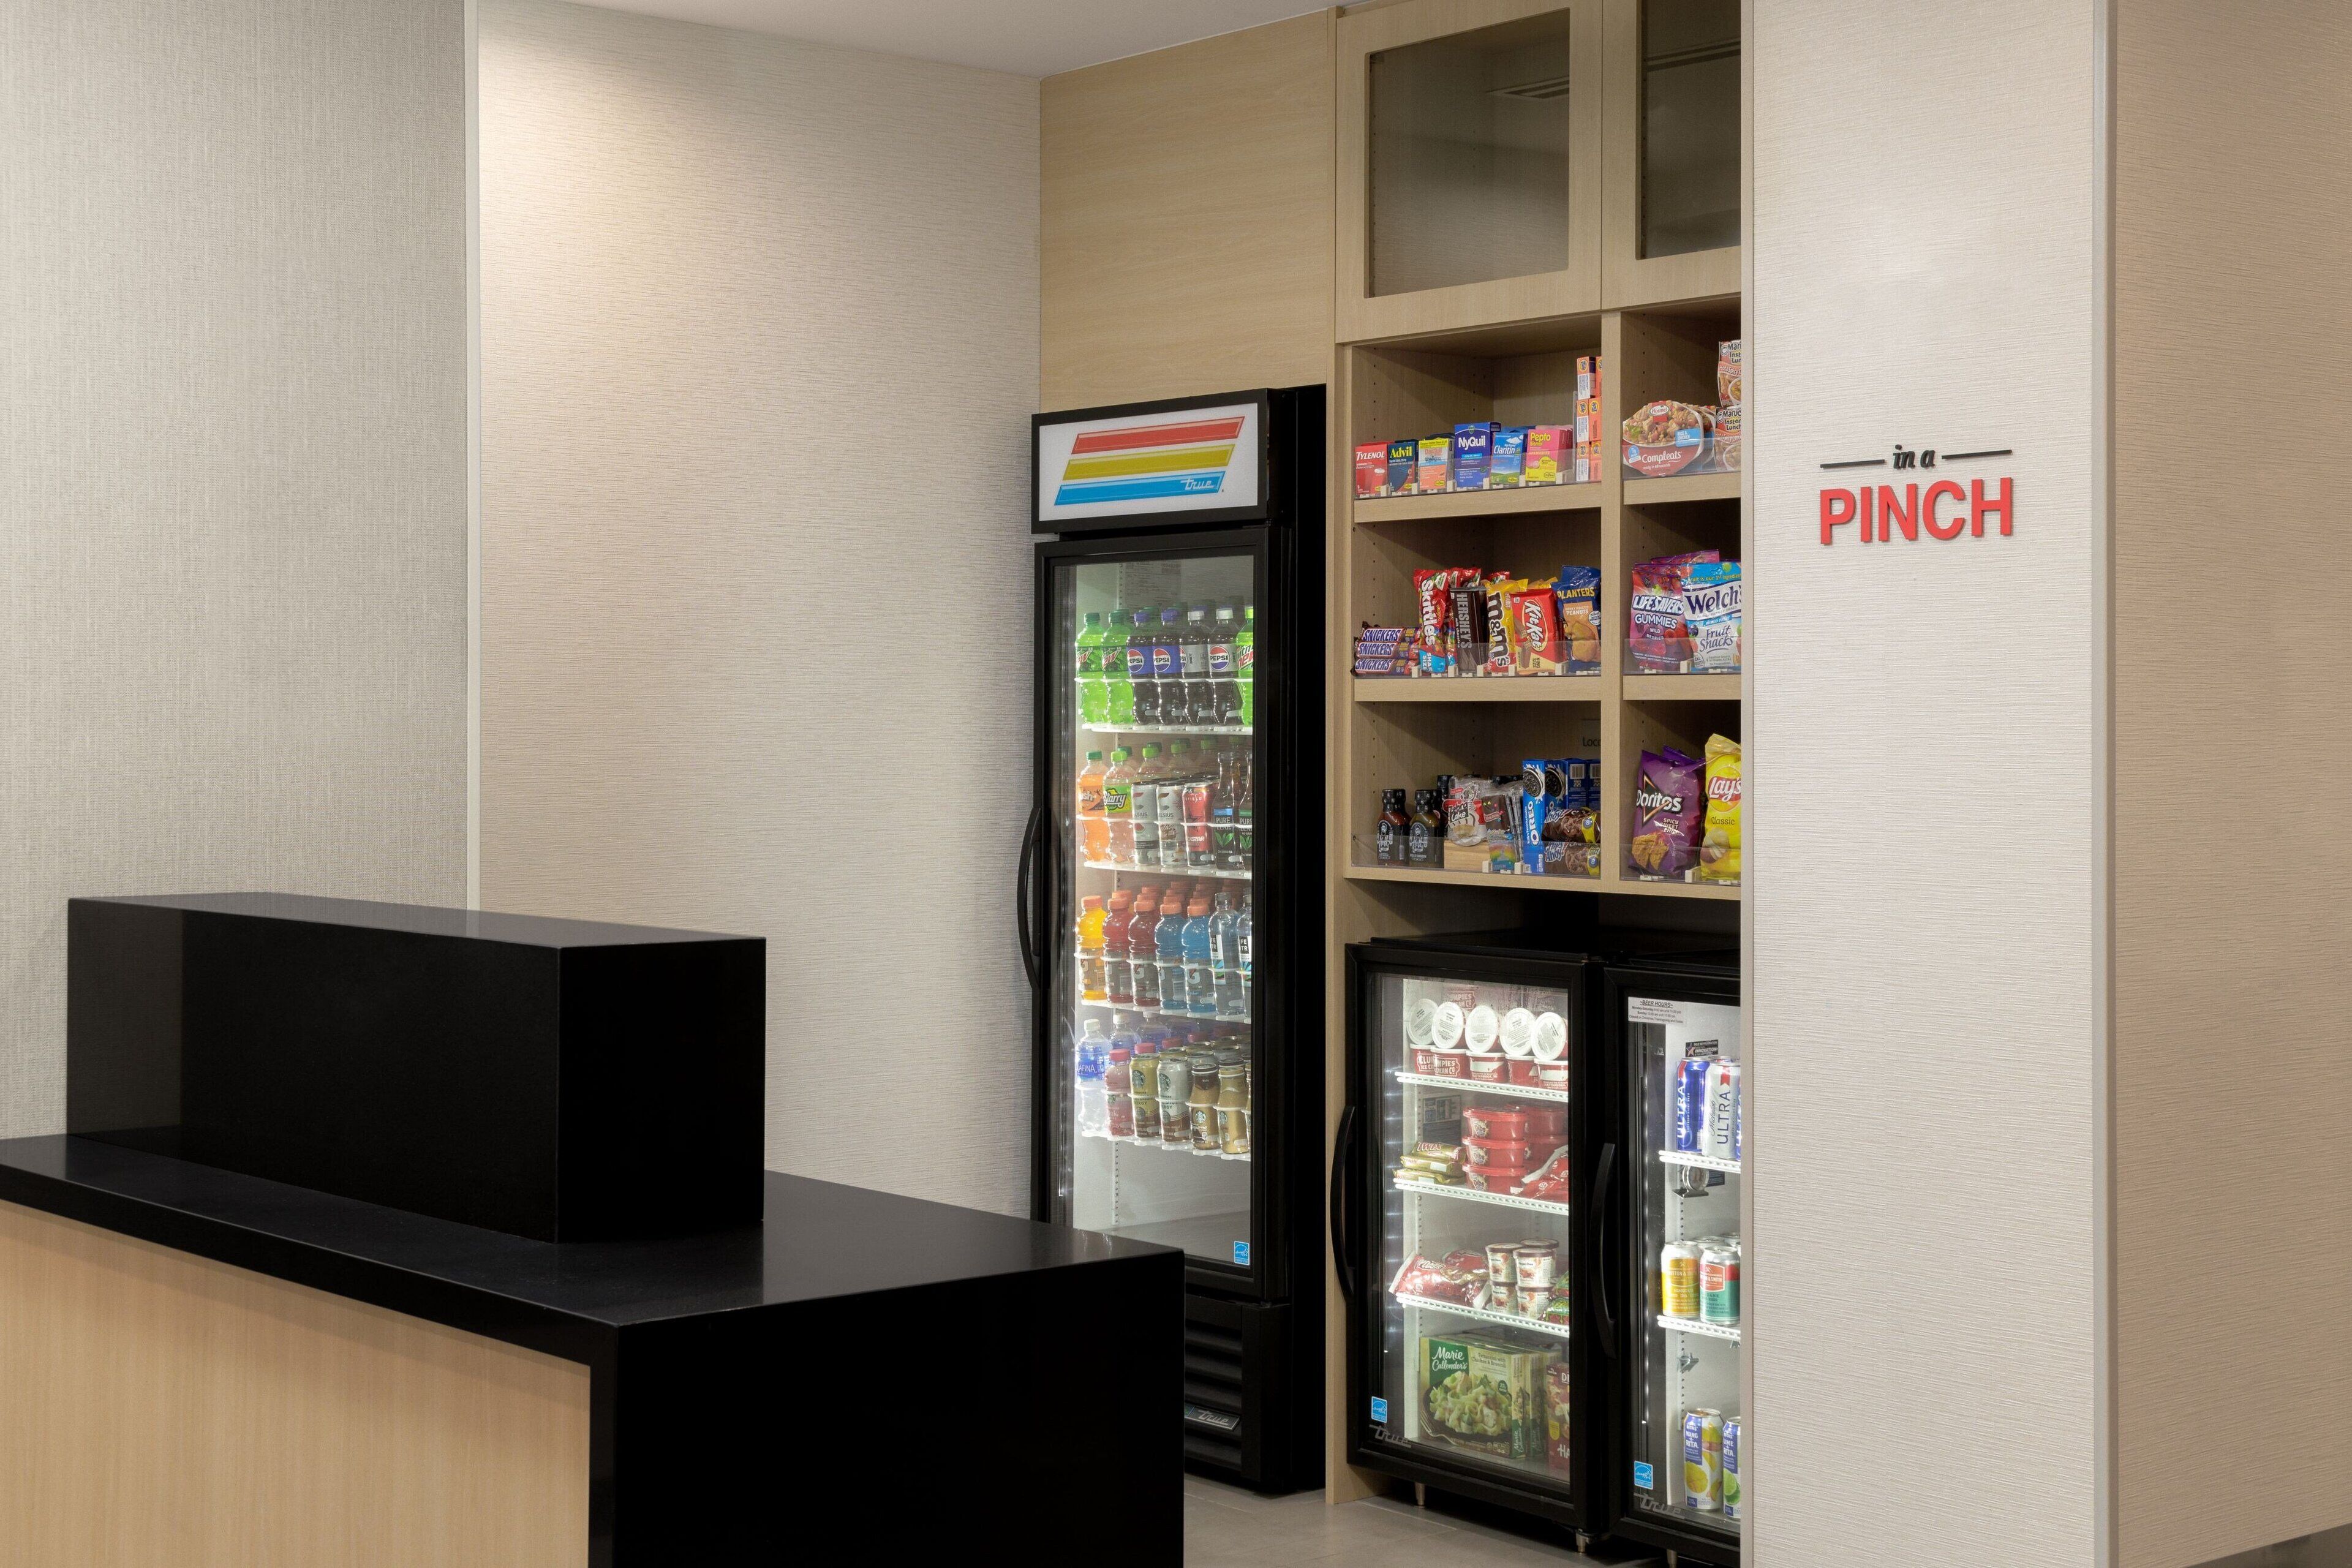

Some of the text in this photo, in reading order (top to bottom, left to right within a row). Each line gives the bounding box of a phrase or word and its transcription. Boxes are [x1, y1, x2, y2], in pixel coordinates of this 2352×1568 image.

[1458, 435, 1486, 450] NyQuil
[1530, 432, 1551, 442] Pepto
[1356, 451, 1385, 461] TYLENOL
[1390, 446, 1412, 458] Advil
[1494, 445, 1515, 454] Claritin
[1642, 451, 1681, 464] Compleats
[1893, 445, 1936, 469] in a
[1181, 477, 1214, 491] true
[1820, 477, 2013, 545] PINCH
[1557, 587, 1595, 599] PLANTERS
[1421, 579, 1438, 646] Skittles
[1457, 592, 1472, 649] HERSHEY'S
[1634, 613, 1678, 629] GUMMIES
[1363, 630, 1401, 641] SNICKERS
[1706, 625, 1732, 639] Fruit
[1359, 643, 1395, 655] SNICKERS
[1700, 636, 1734, 652] Snacks
[1356, 659, 1392, 671] SNICKERS
[1708, 777, 1741, 802] Lay's
[1104, 791, 1126, 809] Starry
[1449, 801, 1468, 813] Zebra
[1637, 790, 1683, 812] Doritos
[1451, 812, 1466, 821] Cake
[1528, 801, 1539, 845] OREO
[1711, 816, 1735, 825] Classic
[1079, 1064, 1096, 1073] AFINA
[1677, 1085, 1686, 1138] ULTRA
[1717, 1090, 1730, 1144] ULTRA
[1432, 1346, 1464, 1360] Marie
[1432, 1359, 1468, 1371] Callender's
[1198, 1410, 1229, 1426] true
[1686, 1439, 1698, 1449] RITA
[1634, 1492, 1685, 1519] true
